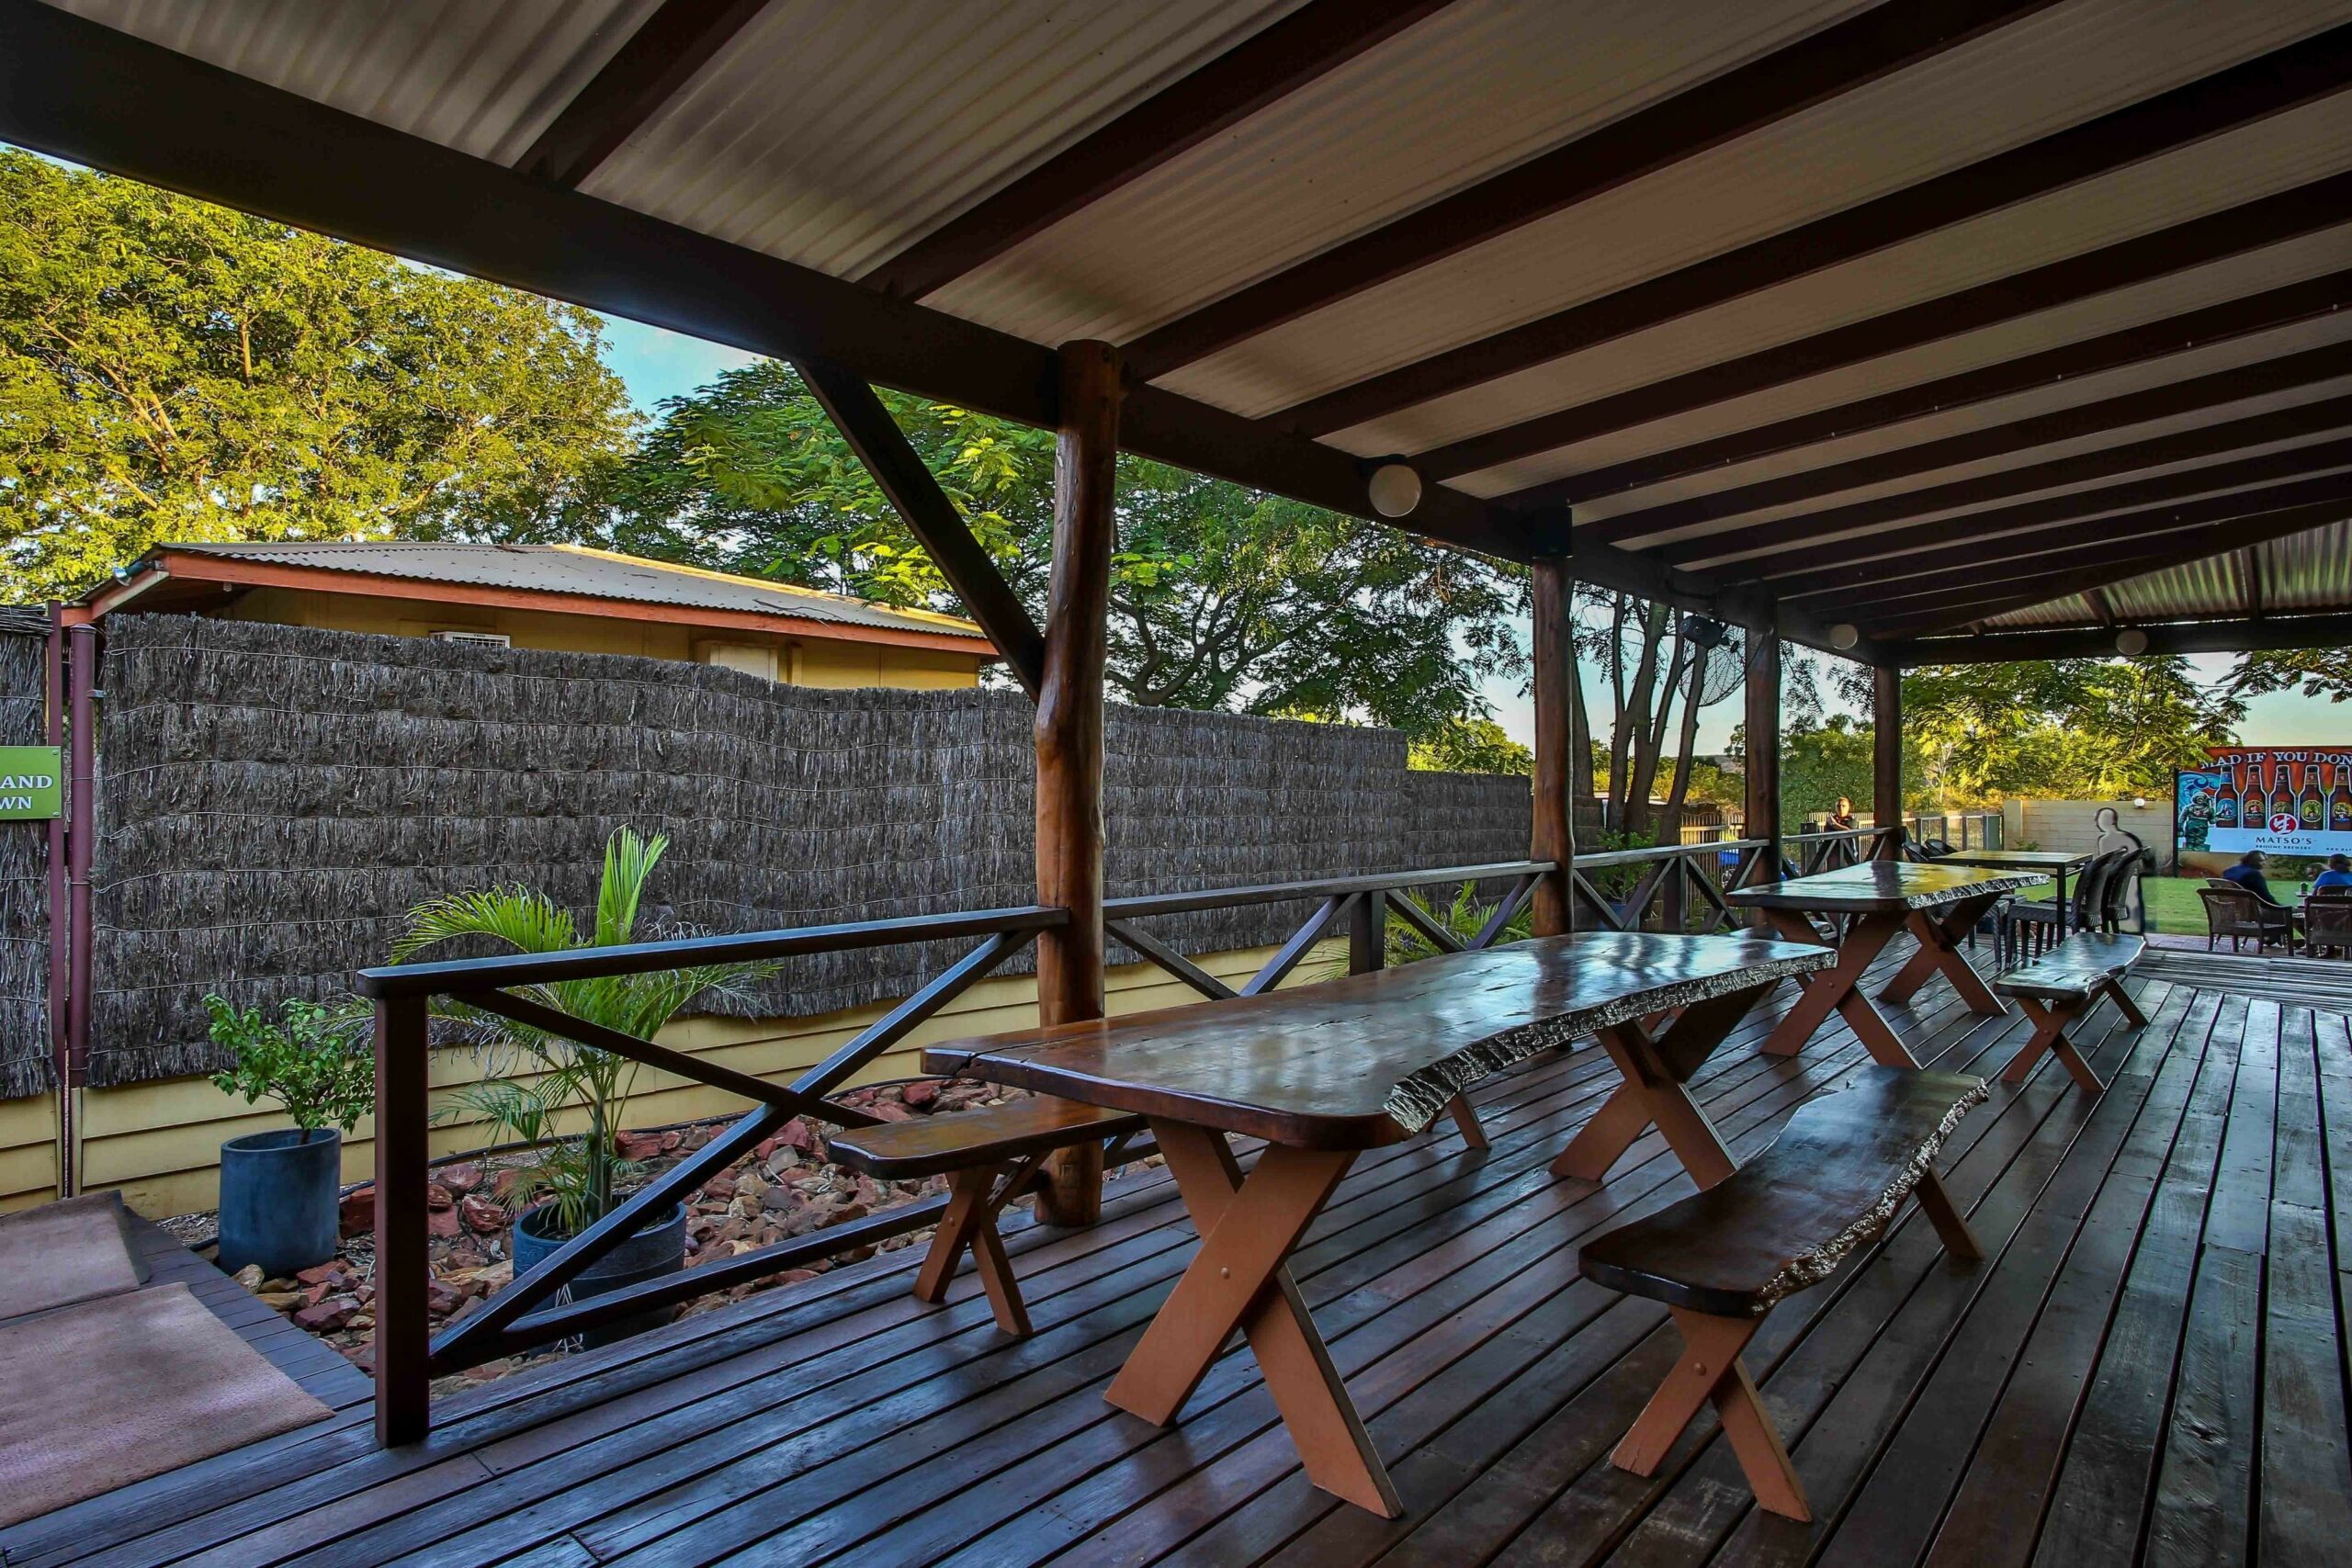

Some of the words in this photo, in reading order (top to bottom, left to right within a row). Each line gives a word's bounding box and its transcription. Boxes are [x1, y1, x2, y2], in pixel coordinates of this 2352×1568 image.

[2245, 752, 2267, 762] IF
[2274, 751, 2308, 761] YOU
[2256, 837, 2312, 845] MATSO'S
